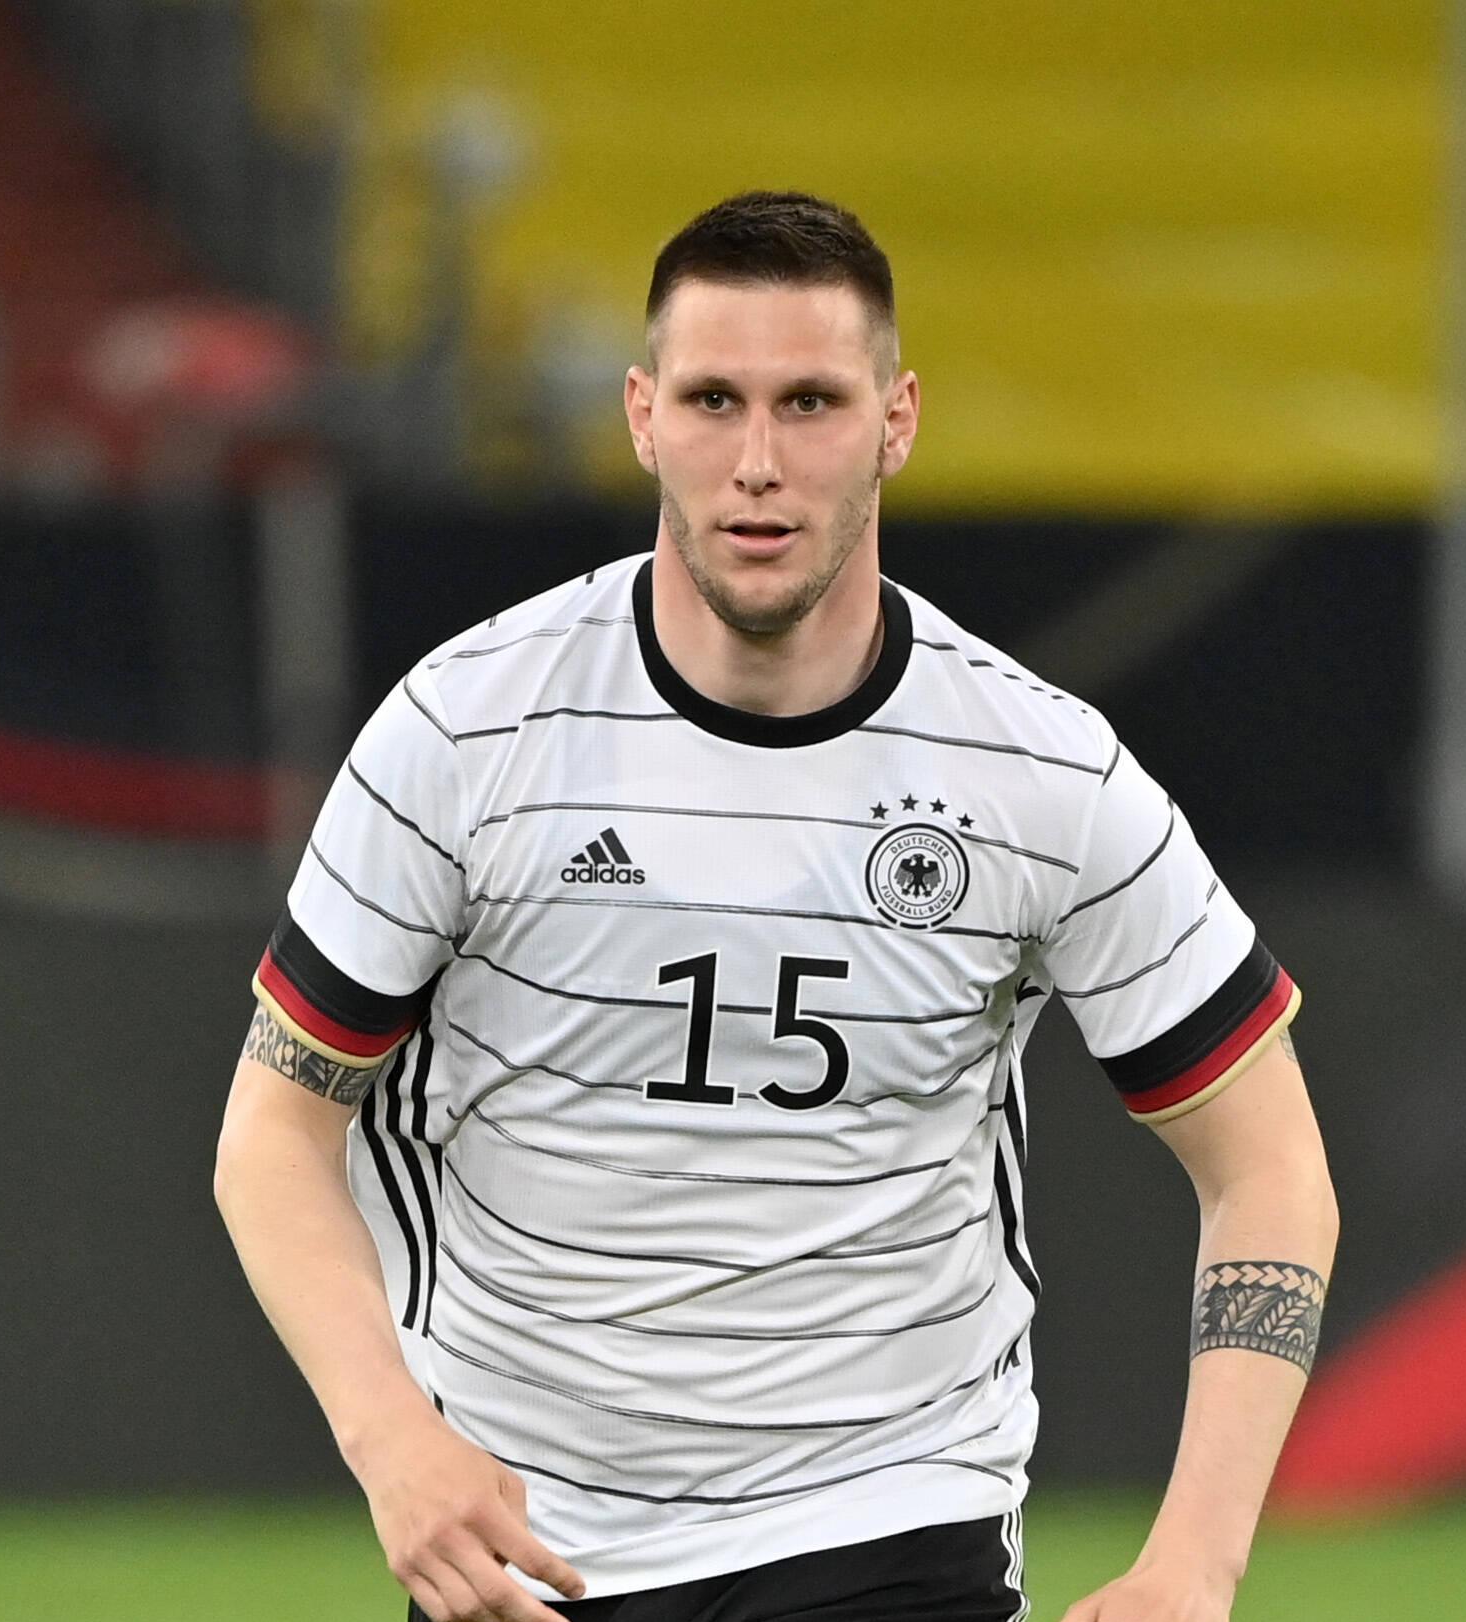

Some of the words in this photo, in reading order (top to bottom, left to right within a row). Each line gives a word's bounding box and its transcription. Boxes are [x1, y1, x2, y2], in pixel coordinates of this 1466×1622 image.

[890, 836, 950, 858] DEUTSCHER
[560, 863, 645, 885] adidas
[881, 884, 953, 915] FUSSBALL-BUND
[644, 950, 851, 1111] 15
